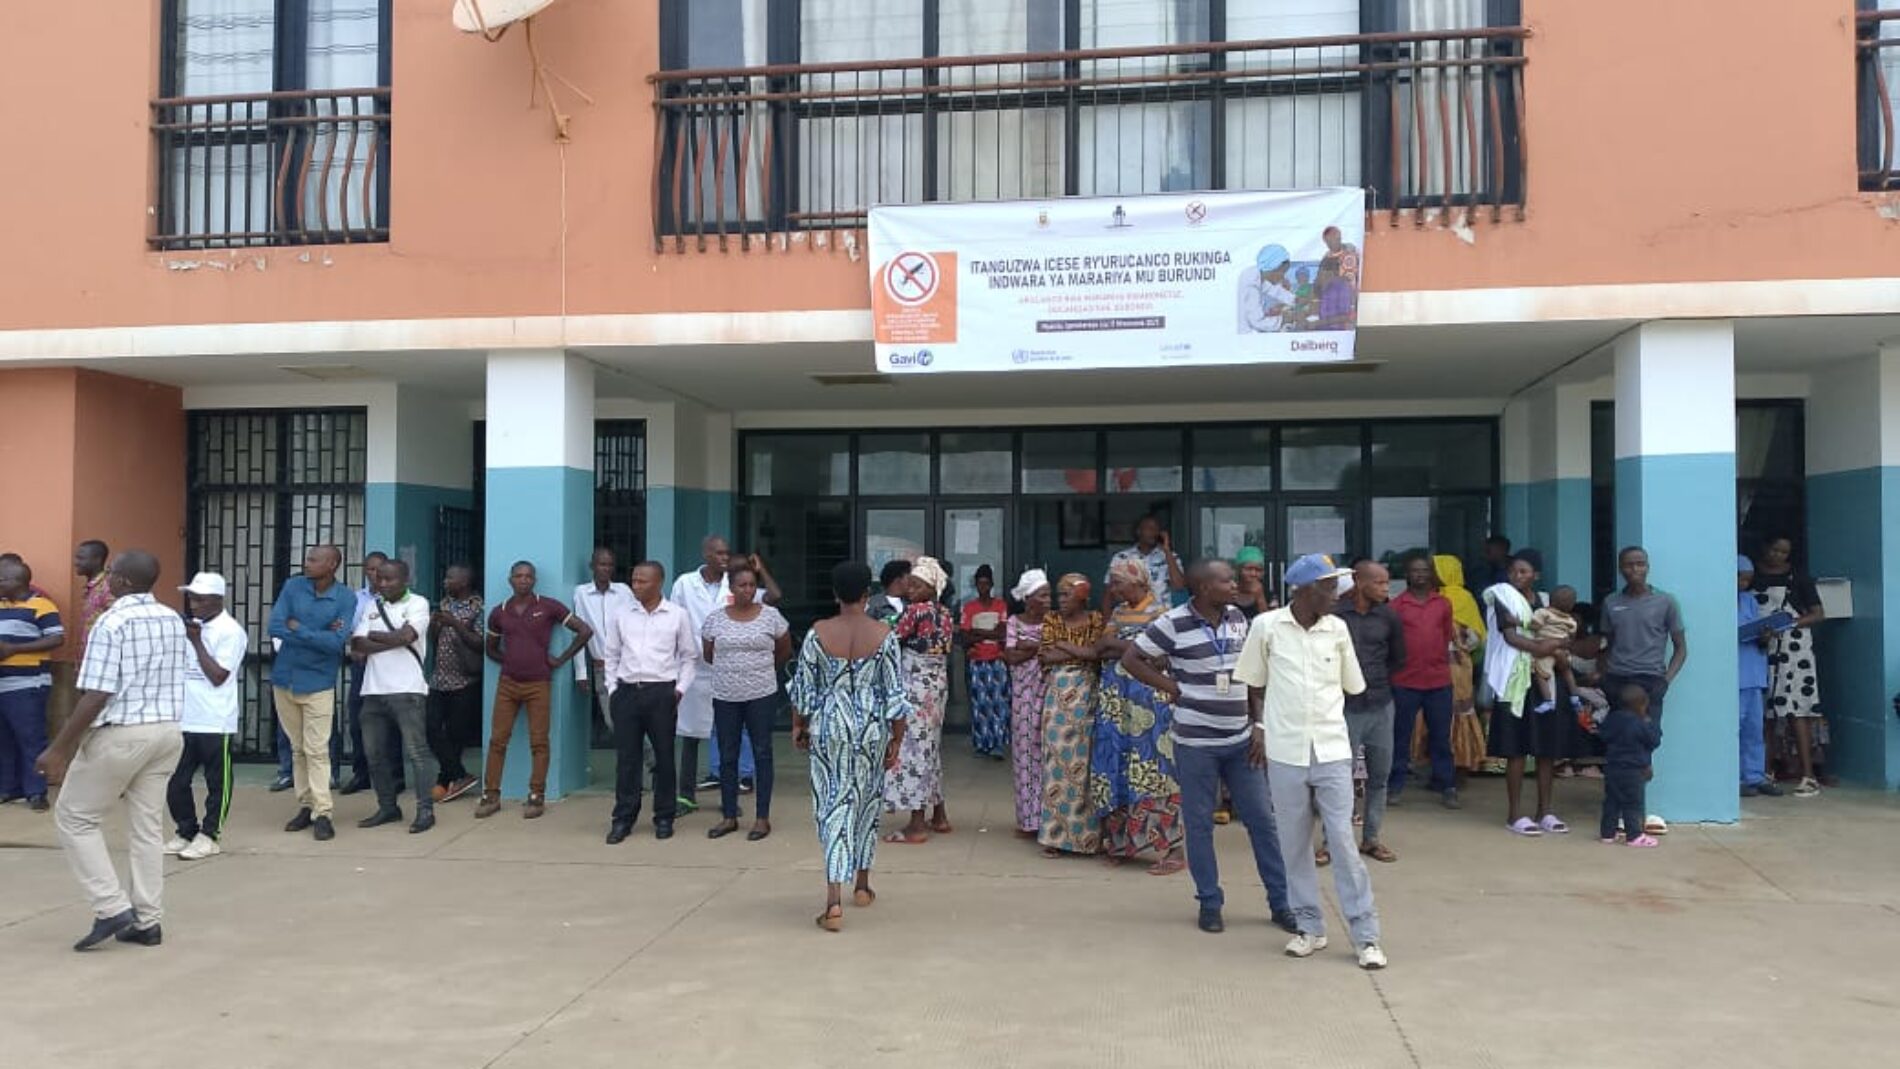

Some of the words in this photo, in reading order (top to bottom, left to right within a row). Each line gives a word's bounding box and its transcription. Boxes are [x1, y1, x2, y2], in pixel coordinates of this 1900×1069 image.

[971, 258, 1041, 274] ITANGUZWA
[1044, 257, 1081, 272] ICESE
[1083, 253, 1170, 270] RYURUCANCO
[1174, 250, 1232, 266] RUKINGA
[988, 274, 1046, 289] INDWARA
[1049, 273, 1064, 287] YA
[1068, 270, 1132, 286] MARARIYA
[1136, 269, 1155, 283] MU
[1158, 267, 1216, 283] BURUNDI
[1291, 340, 1338, 353] Dalberg
[889, 352, 916, 364] Gavi
